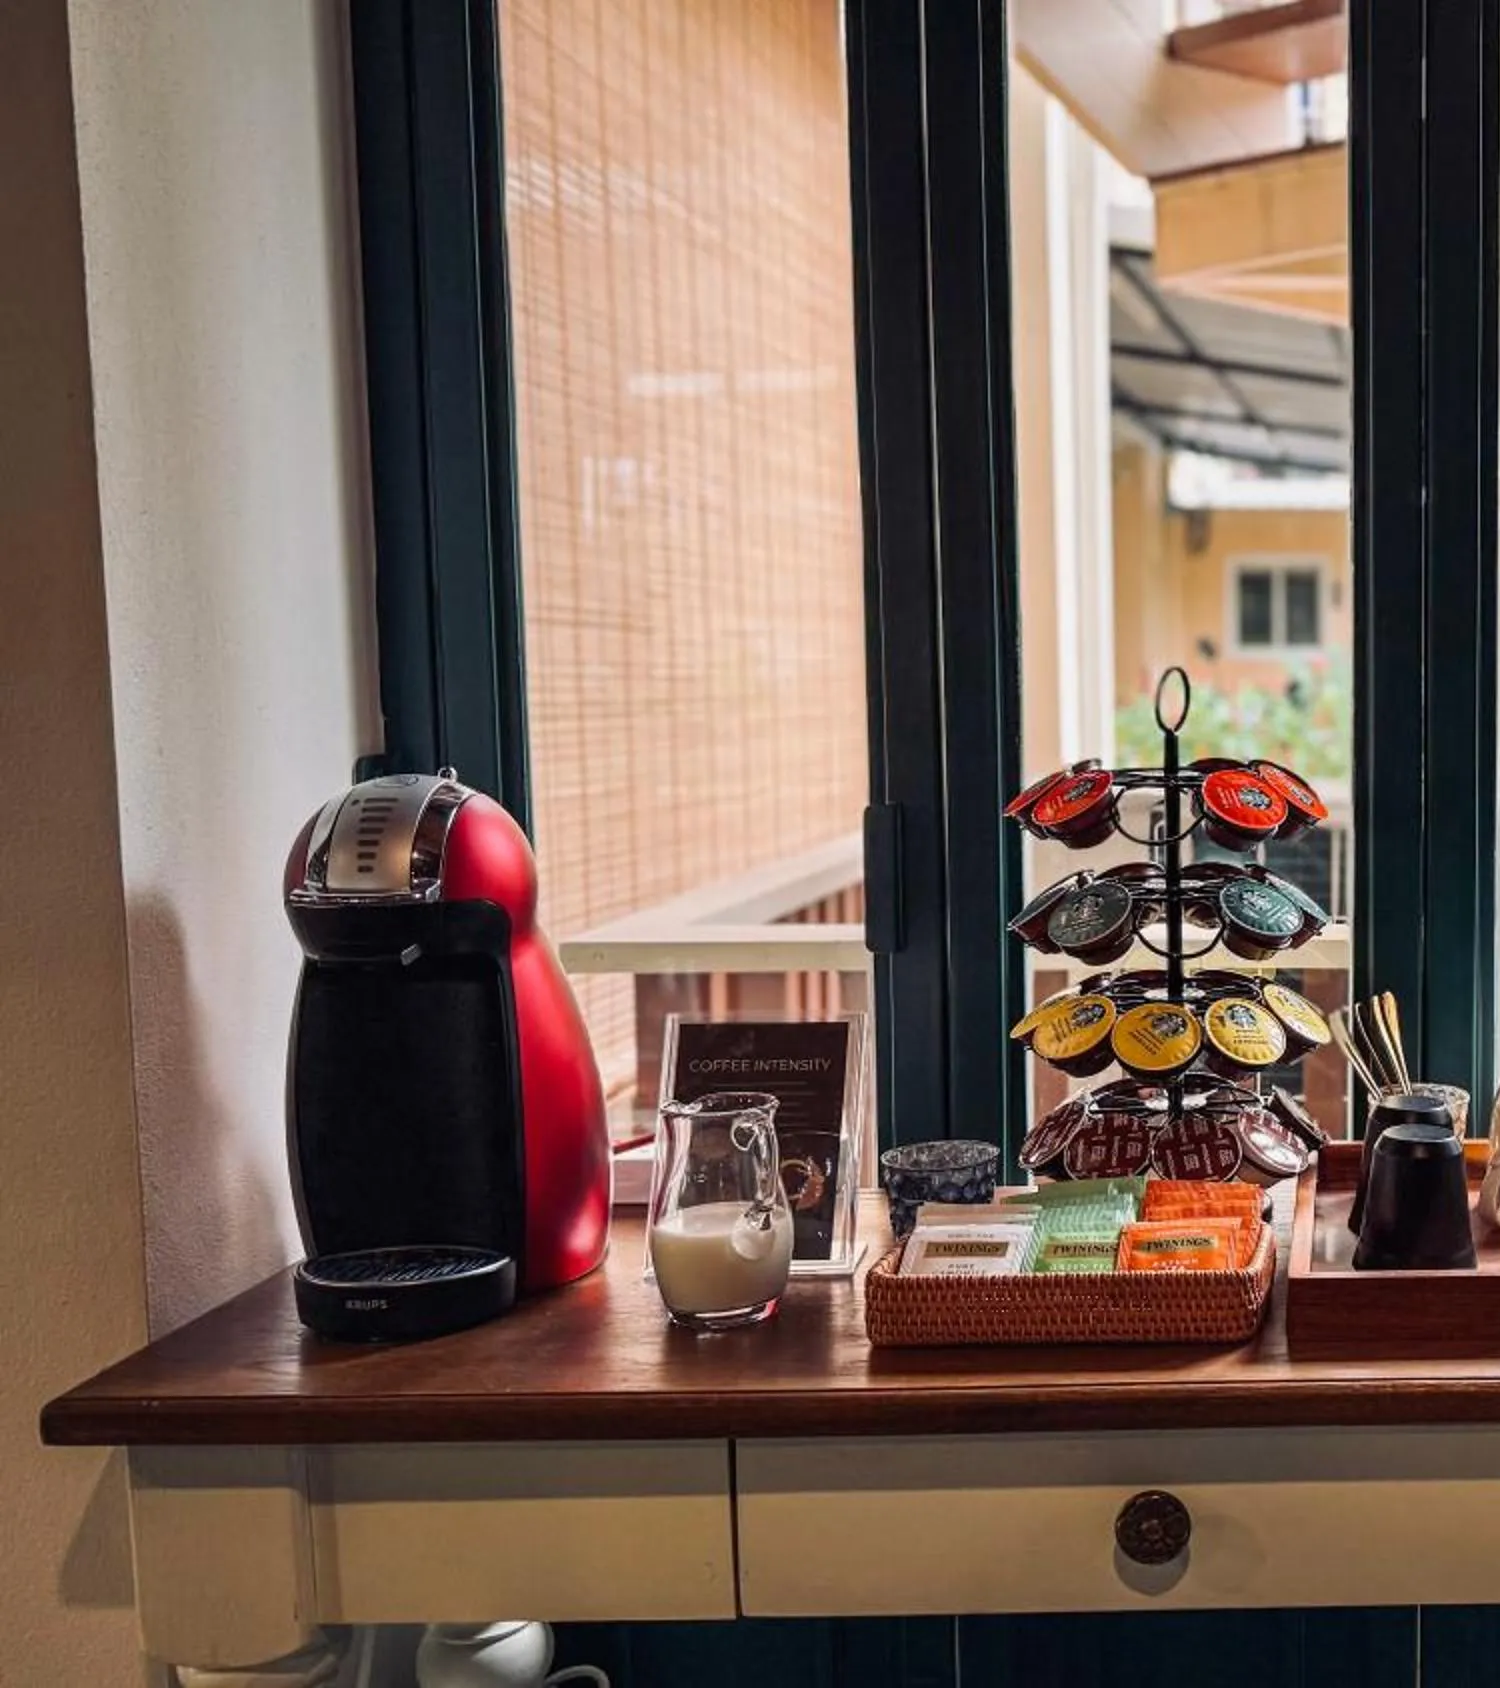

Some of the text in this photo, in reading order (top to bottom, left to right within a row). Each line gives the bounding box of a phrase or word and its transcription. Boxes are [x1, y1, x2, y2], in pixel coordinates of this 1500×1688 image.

[689, 1058, 832, 1073] COFFEE INTENSITY
[933, 1243, 1001, 1254] TWININGS
[1145, 1237, 1211, 1251] TWININGS
[345, 1299, 388, 1310] KRUPS
